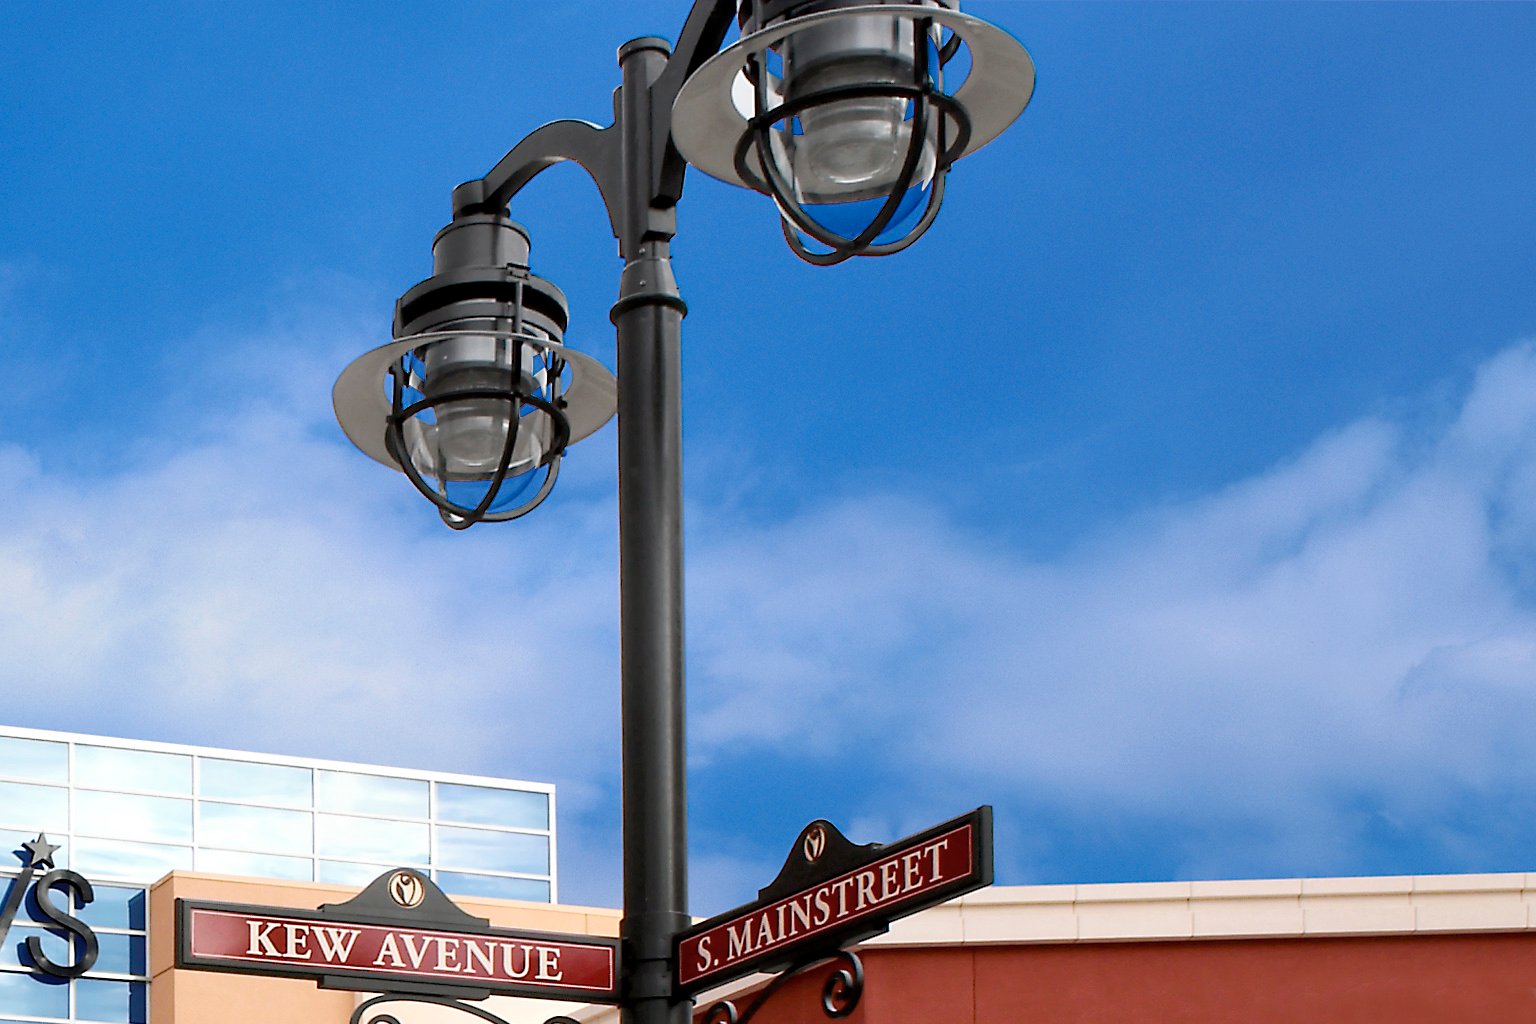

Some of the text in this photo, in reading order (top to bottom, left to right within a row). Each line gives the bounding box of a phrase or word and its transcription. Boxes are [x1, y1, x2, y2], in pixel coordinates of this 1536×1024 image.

[246, 920, 563, 982] KEW AVENUE
[696, 839, 949, 973] S. MAINSTREET
